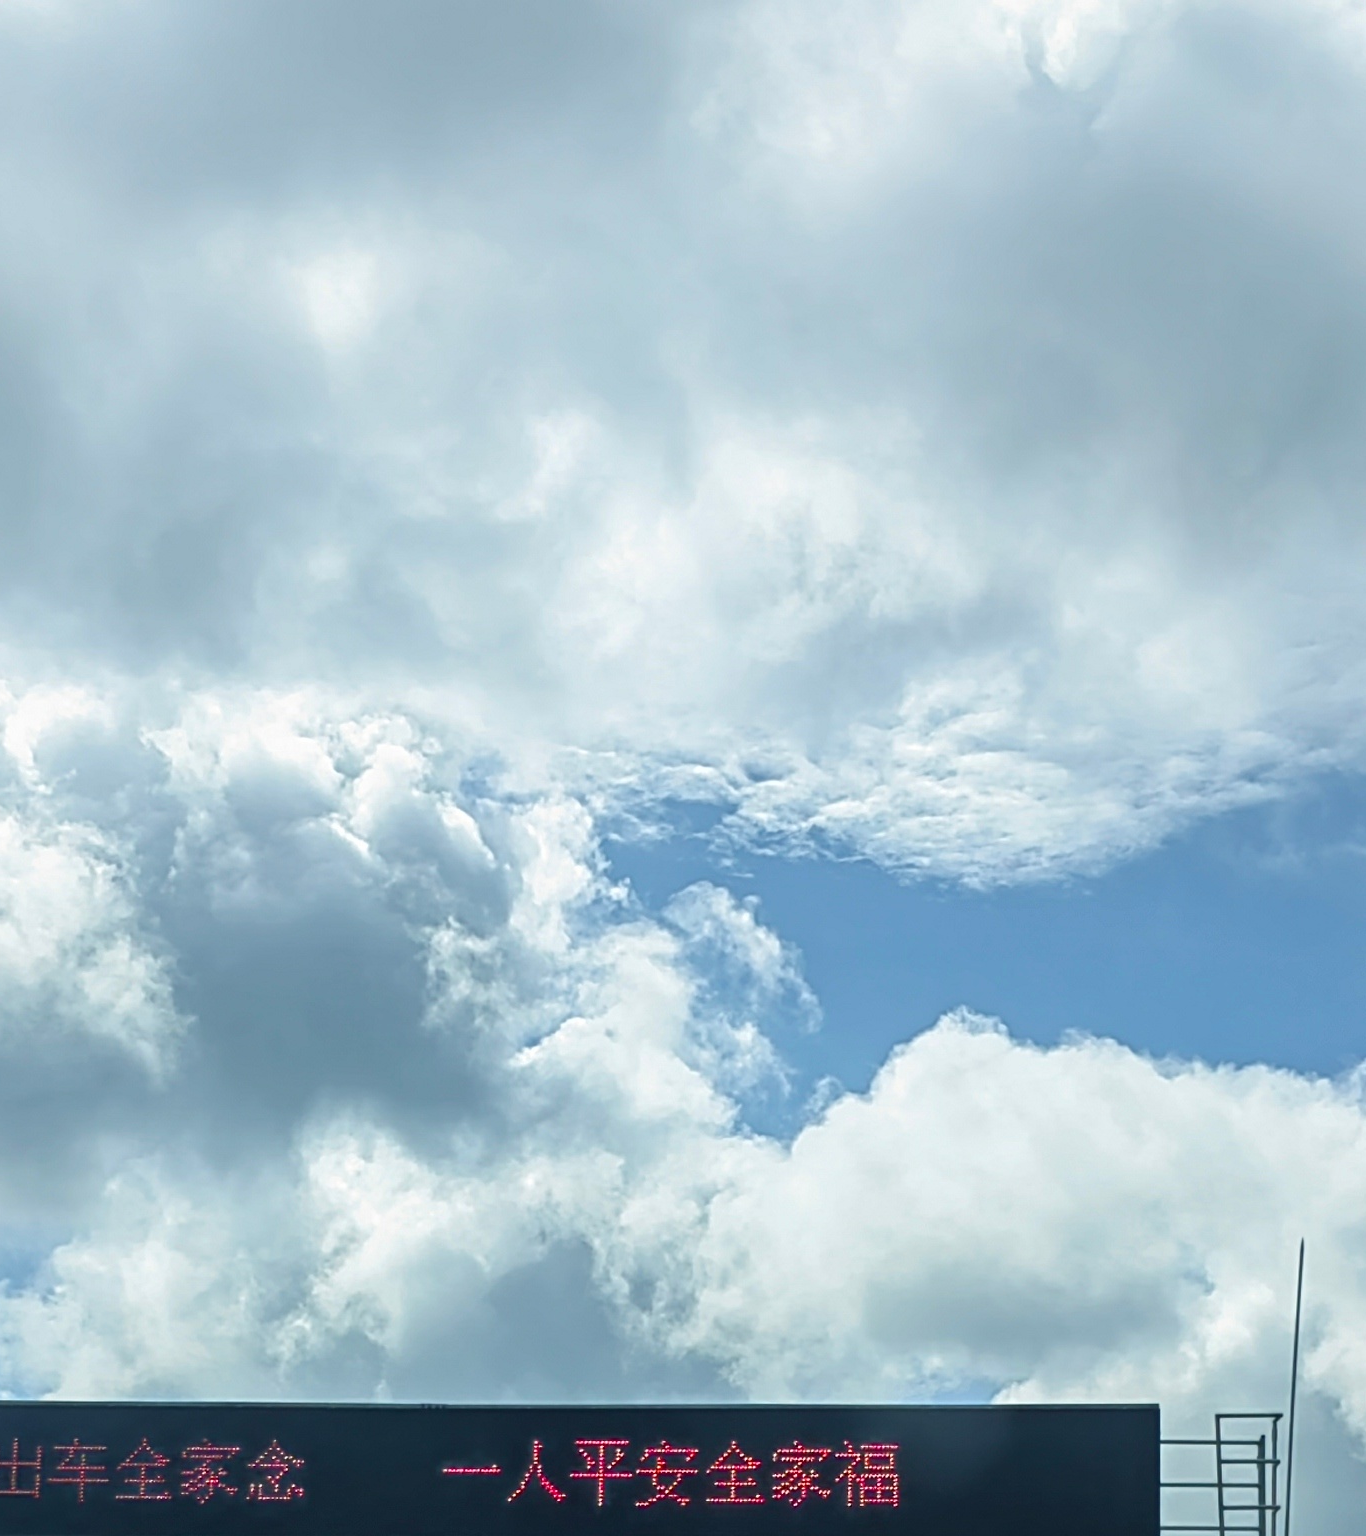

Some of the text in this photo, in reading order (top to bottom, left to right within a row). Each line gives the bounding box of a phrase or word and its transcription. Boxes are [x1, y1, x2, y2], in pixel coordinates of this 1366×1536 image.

[441, 1438, 901, 1508] 一人平安全家福
